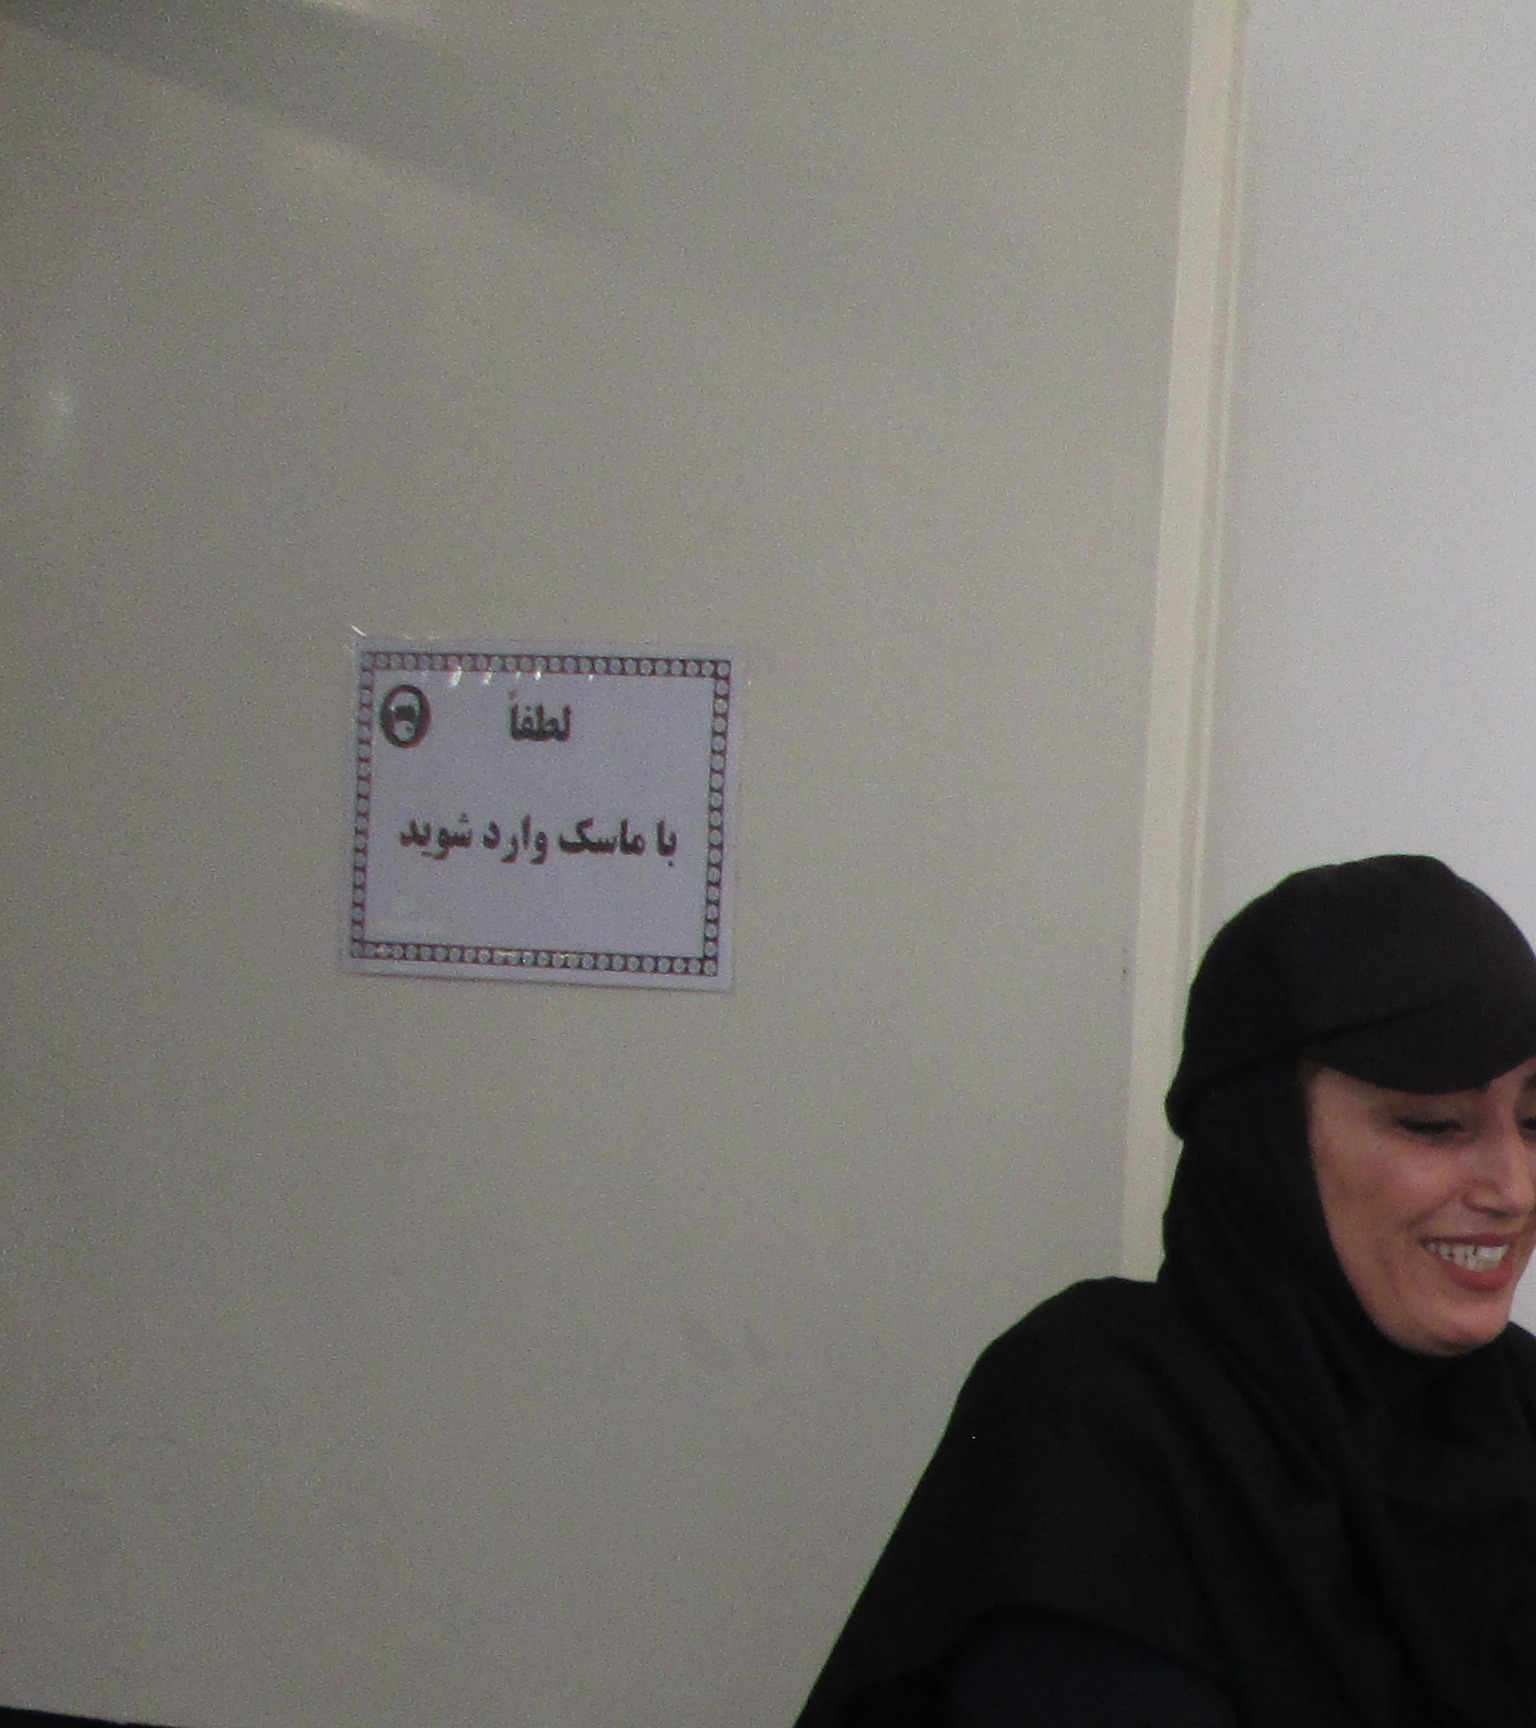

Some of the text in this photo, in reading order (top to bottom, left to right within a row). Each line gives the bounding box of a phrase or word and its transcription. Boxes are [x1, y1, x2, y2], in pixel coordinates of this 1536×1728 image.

[400, 812, 678, 867] با ماسک وارد شوید
